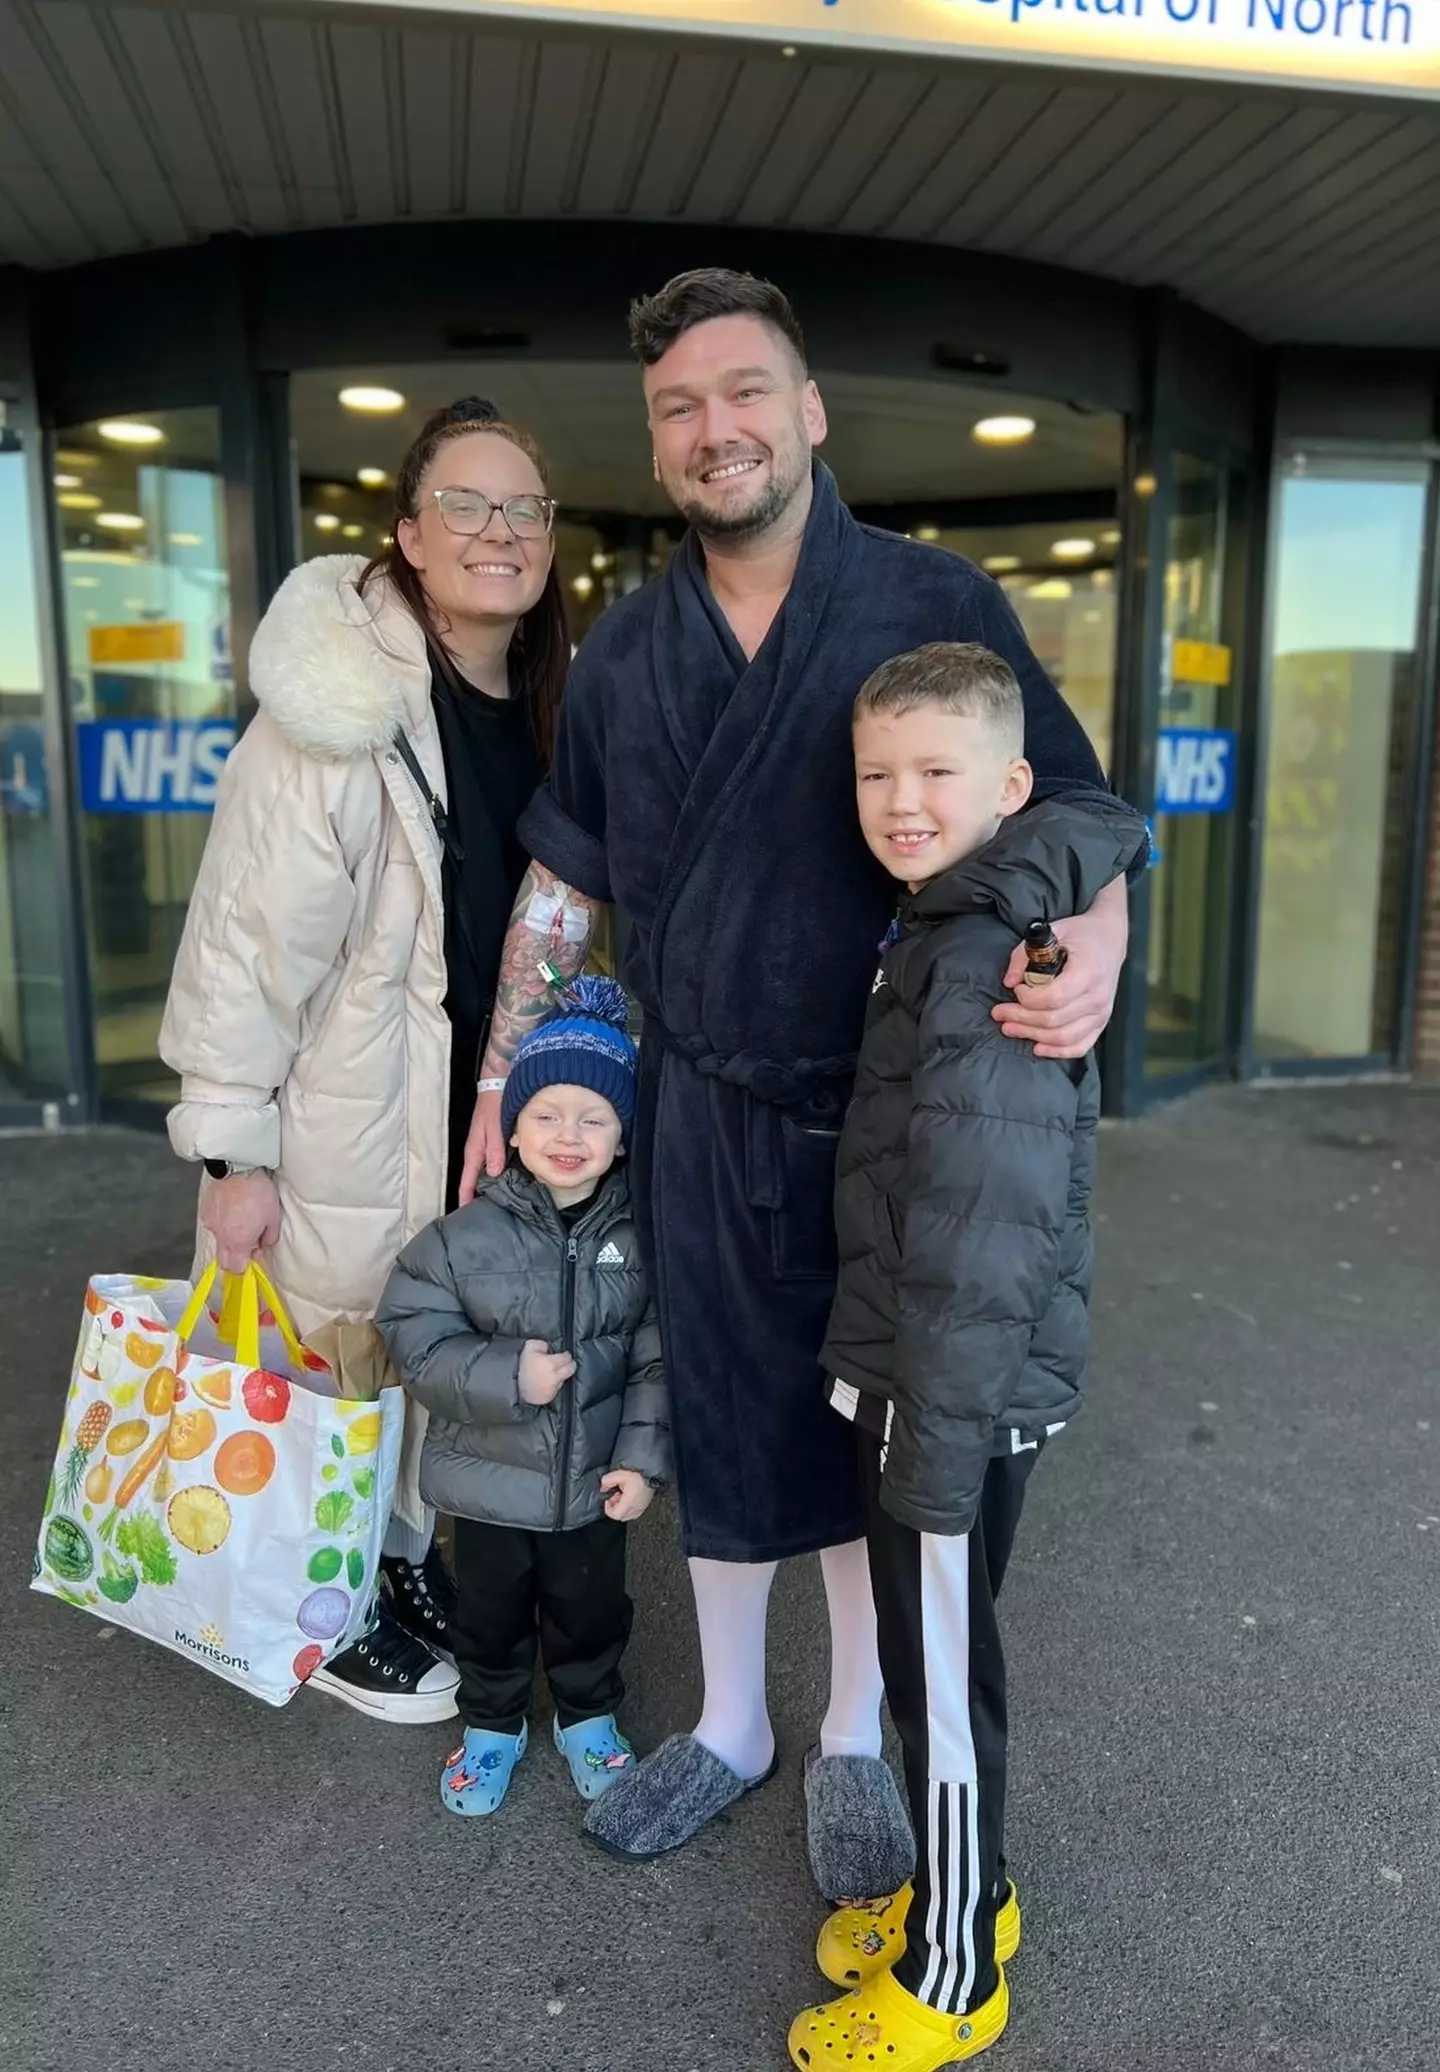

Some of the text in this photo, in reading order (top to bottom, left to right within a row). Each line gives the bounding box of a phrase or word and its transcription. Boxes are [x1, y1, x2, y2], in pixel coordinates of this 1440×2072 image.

[1246, 0, 1411, 44] North
[101, 728, 236, 802] NHS
[1156, 736, 1230, 804] NHS
[174, 1629, 250, 1672] Morrisons
